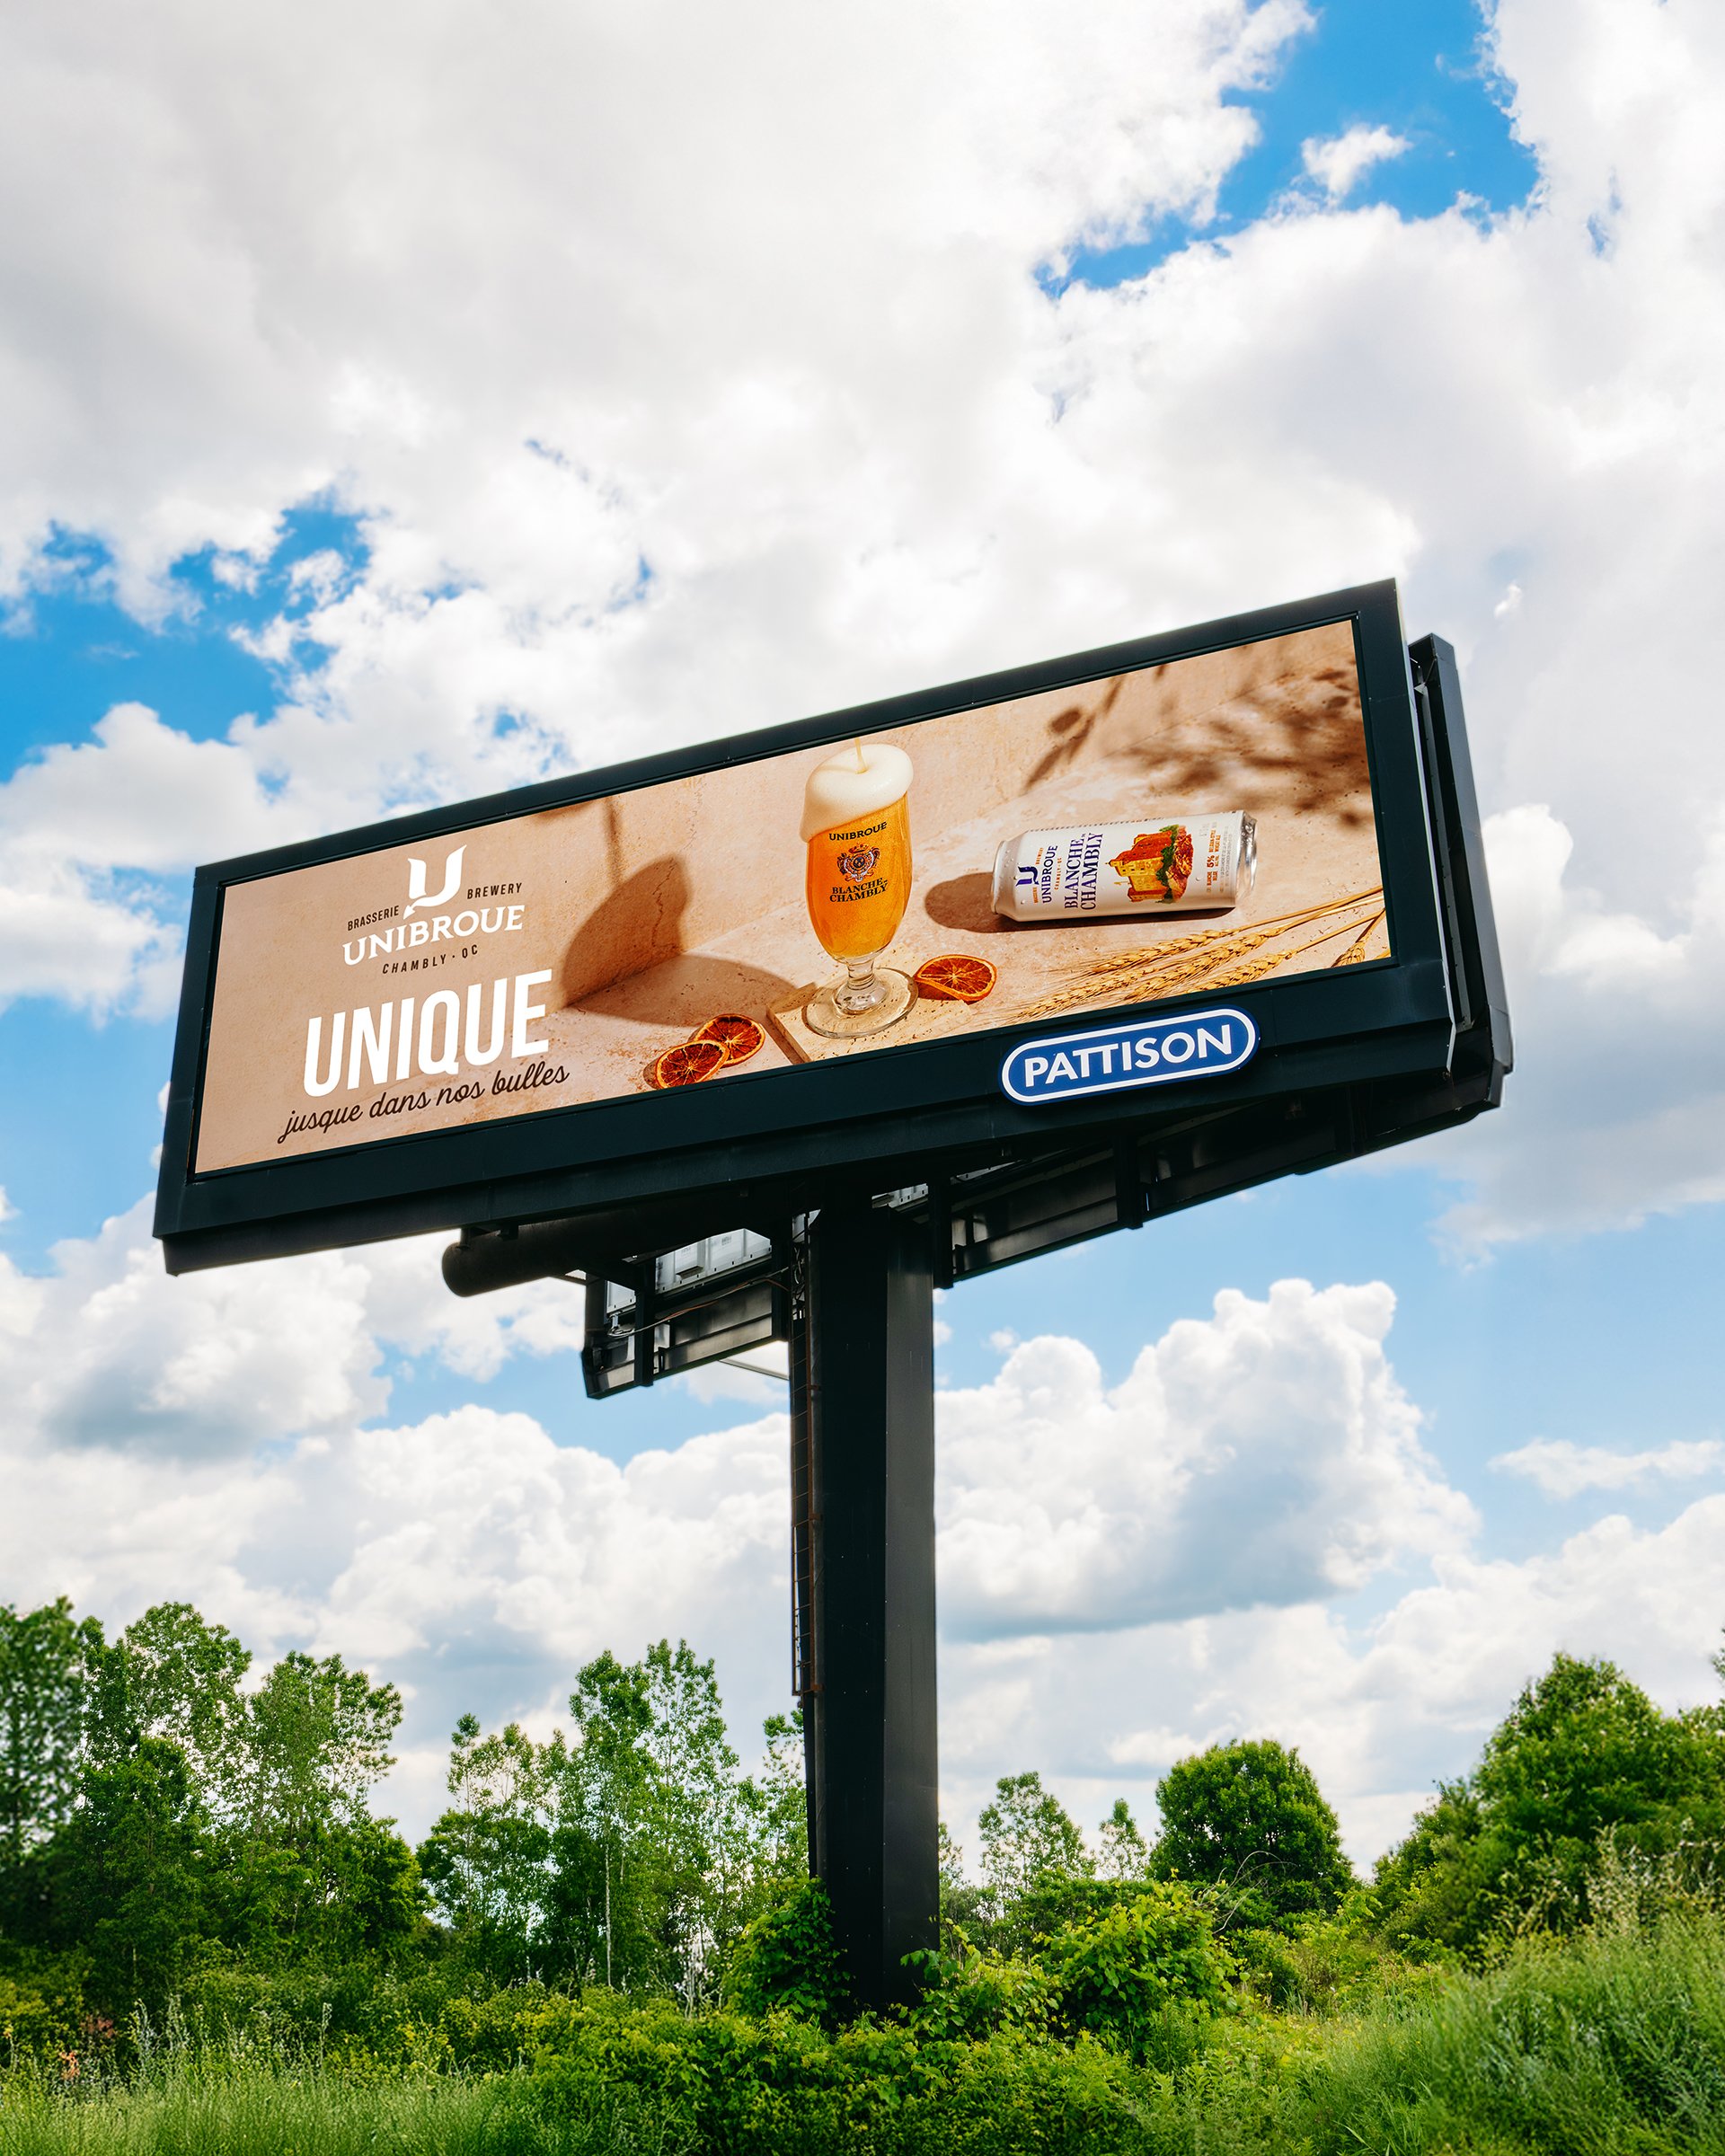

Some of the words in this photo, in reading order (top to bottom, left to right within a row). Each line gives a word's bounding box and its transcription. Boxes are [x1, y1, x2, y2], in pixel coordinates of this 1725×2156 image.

[828, 821, 888, 841] UNIBROUE
[466, 882, 523, 899] BREWERY
[1041, 845, 1058, 904] UNIBROUE
[1064, 838, 1084, 909] BLANCHE
[1080, 832, 1103, 910] CHAMBLY
[1207, 854, 1215, 868] 5%
[347, 905, 400, 932] BRASSERIE
[829, 883, 888, 902] CHAMBLY
[342, 905, 525, 966] UNIBROUE
[382, 953, 447, 975] CHAMBLY
[462, 944, 479, 959] QC
[303, 968, 553, 1098] UNIQUE
[1024, 1024, 1232, 1088] PATTISON
[277, 1103, 363, 1144] jusque
[369, 1091, 431, 1119] dans
[436, 1081, 485, 1107] nos
[491, 1061, 571, 1097] bulles
